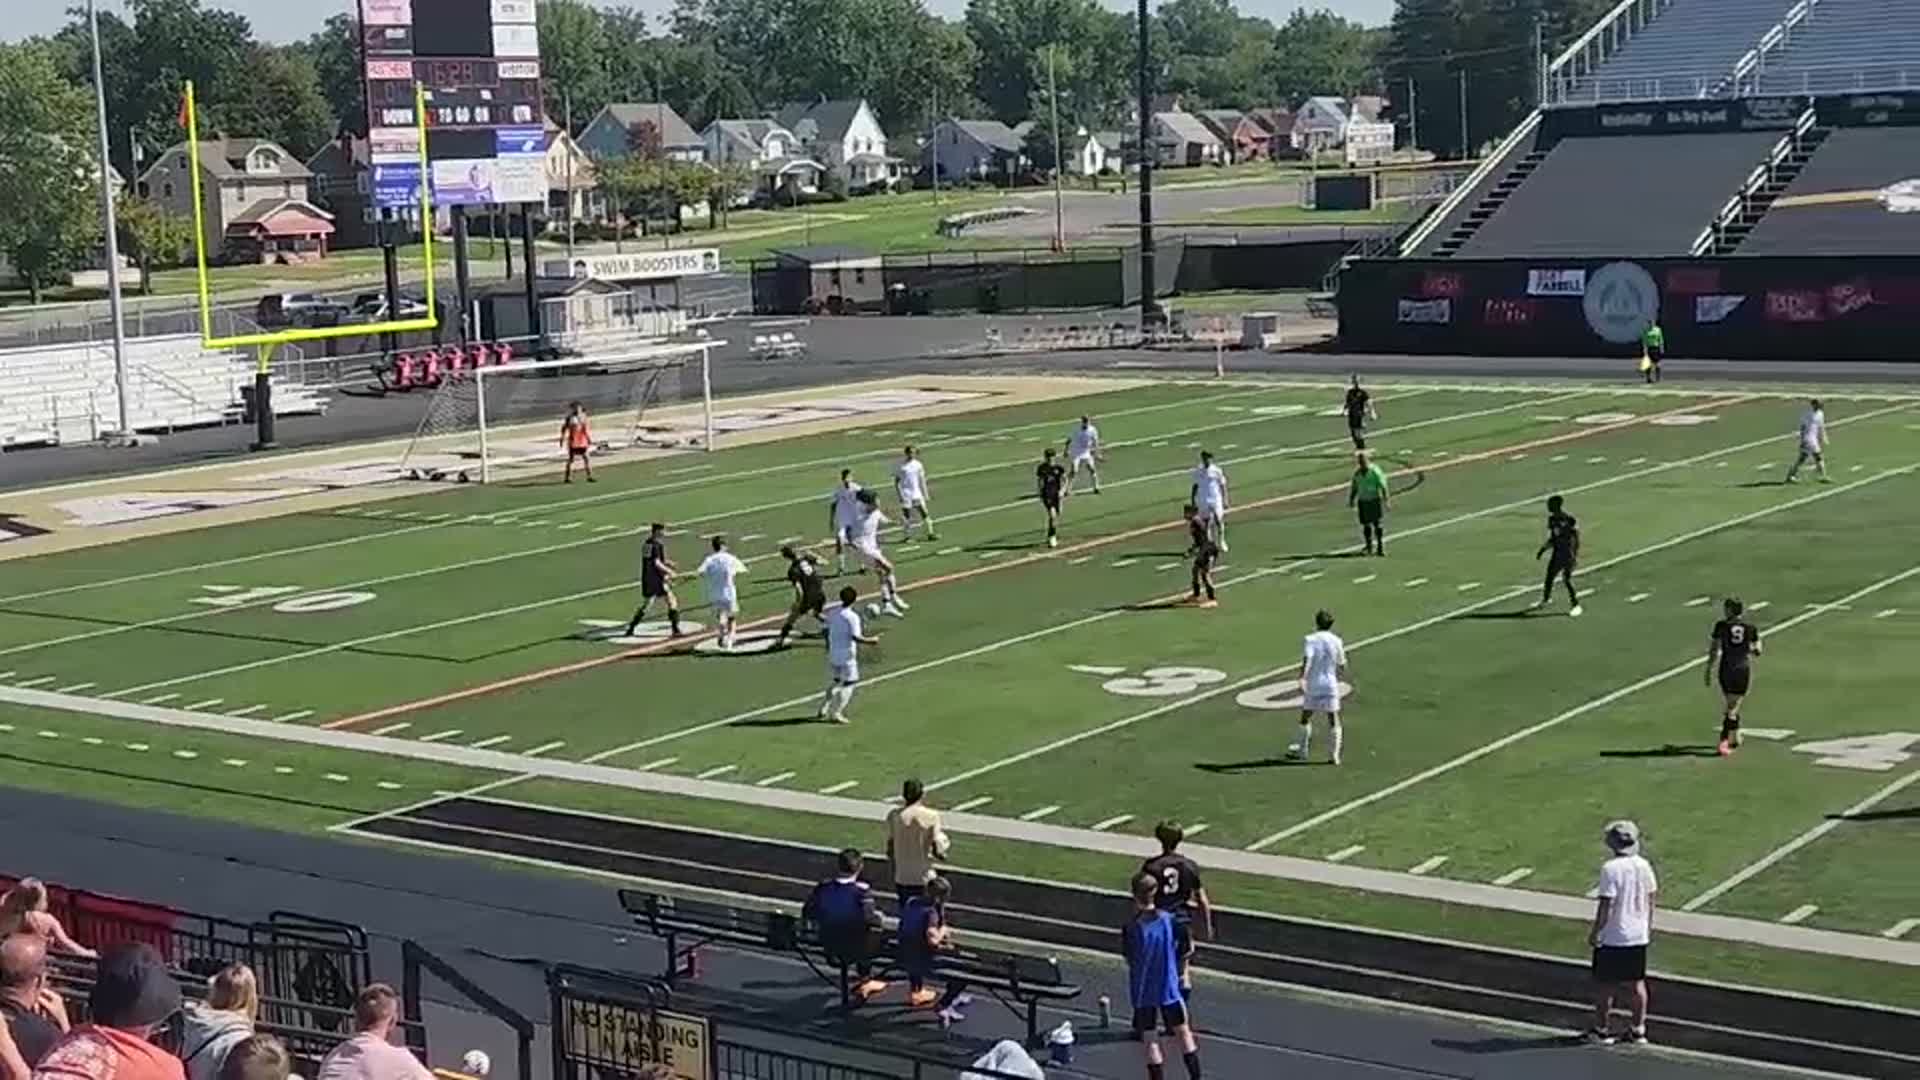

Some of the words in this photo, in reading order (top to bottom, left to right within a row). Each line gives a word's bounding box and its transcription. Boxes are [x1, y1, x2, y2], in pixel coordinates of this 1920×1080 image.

[593, 258, 631, 276] SWIM
[633, 254, 698, 273] BOOSTERS
[1730, 625, 1745, 644] 9
[1101, 665, 1353, 709] 30
[1162, 866, 1180, 895] 3
[604, 1010, 699, 1049] STANDING
